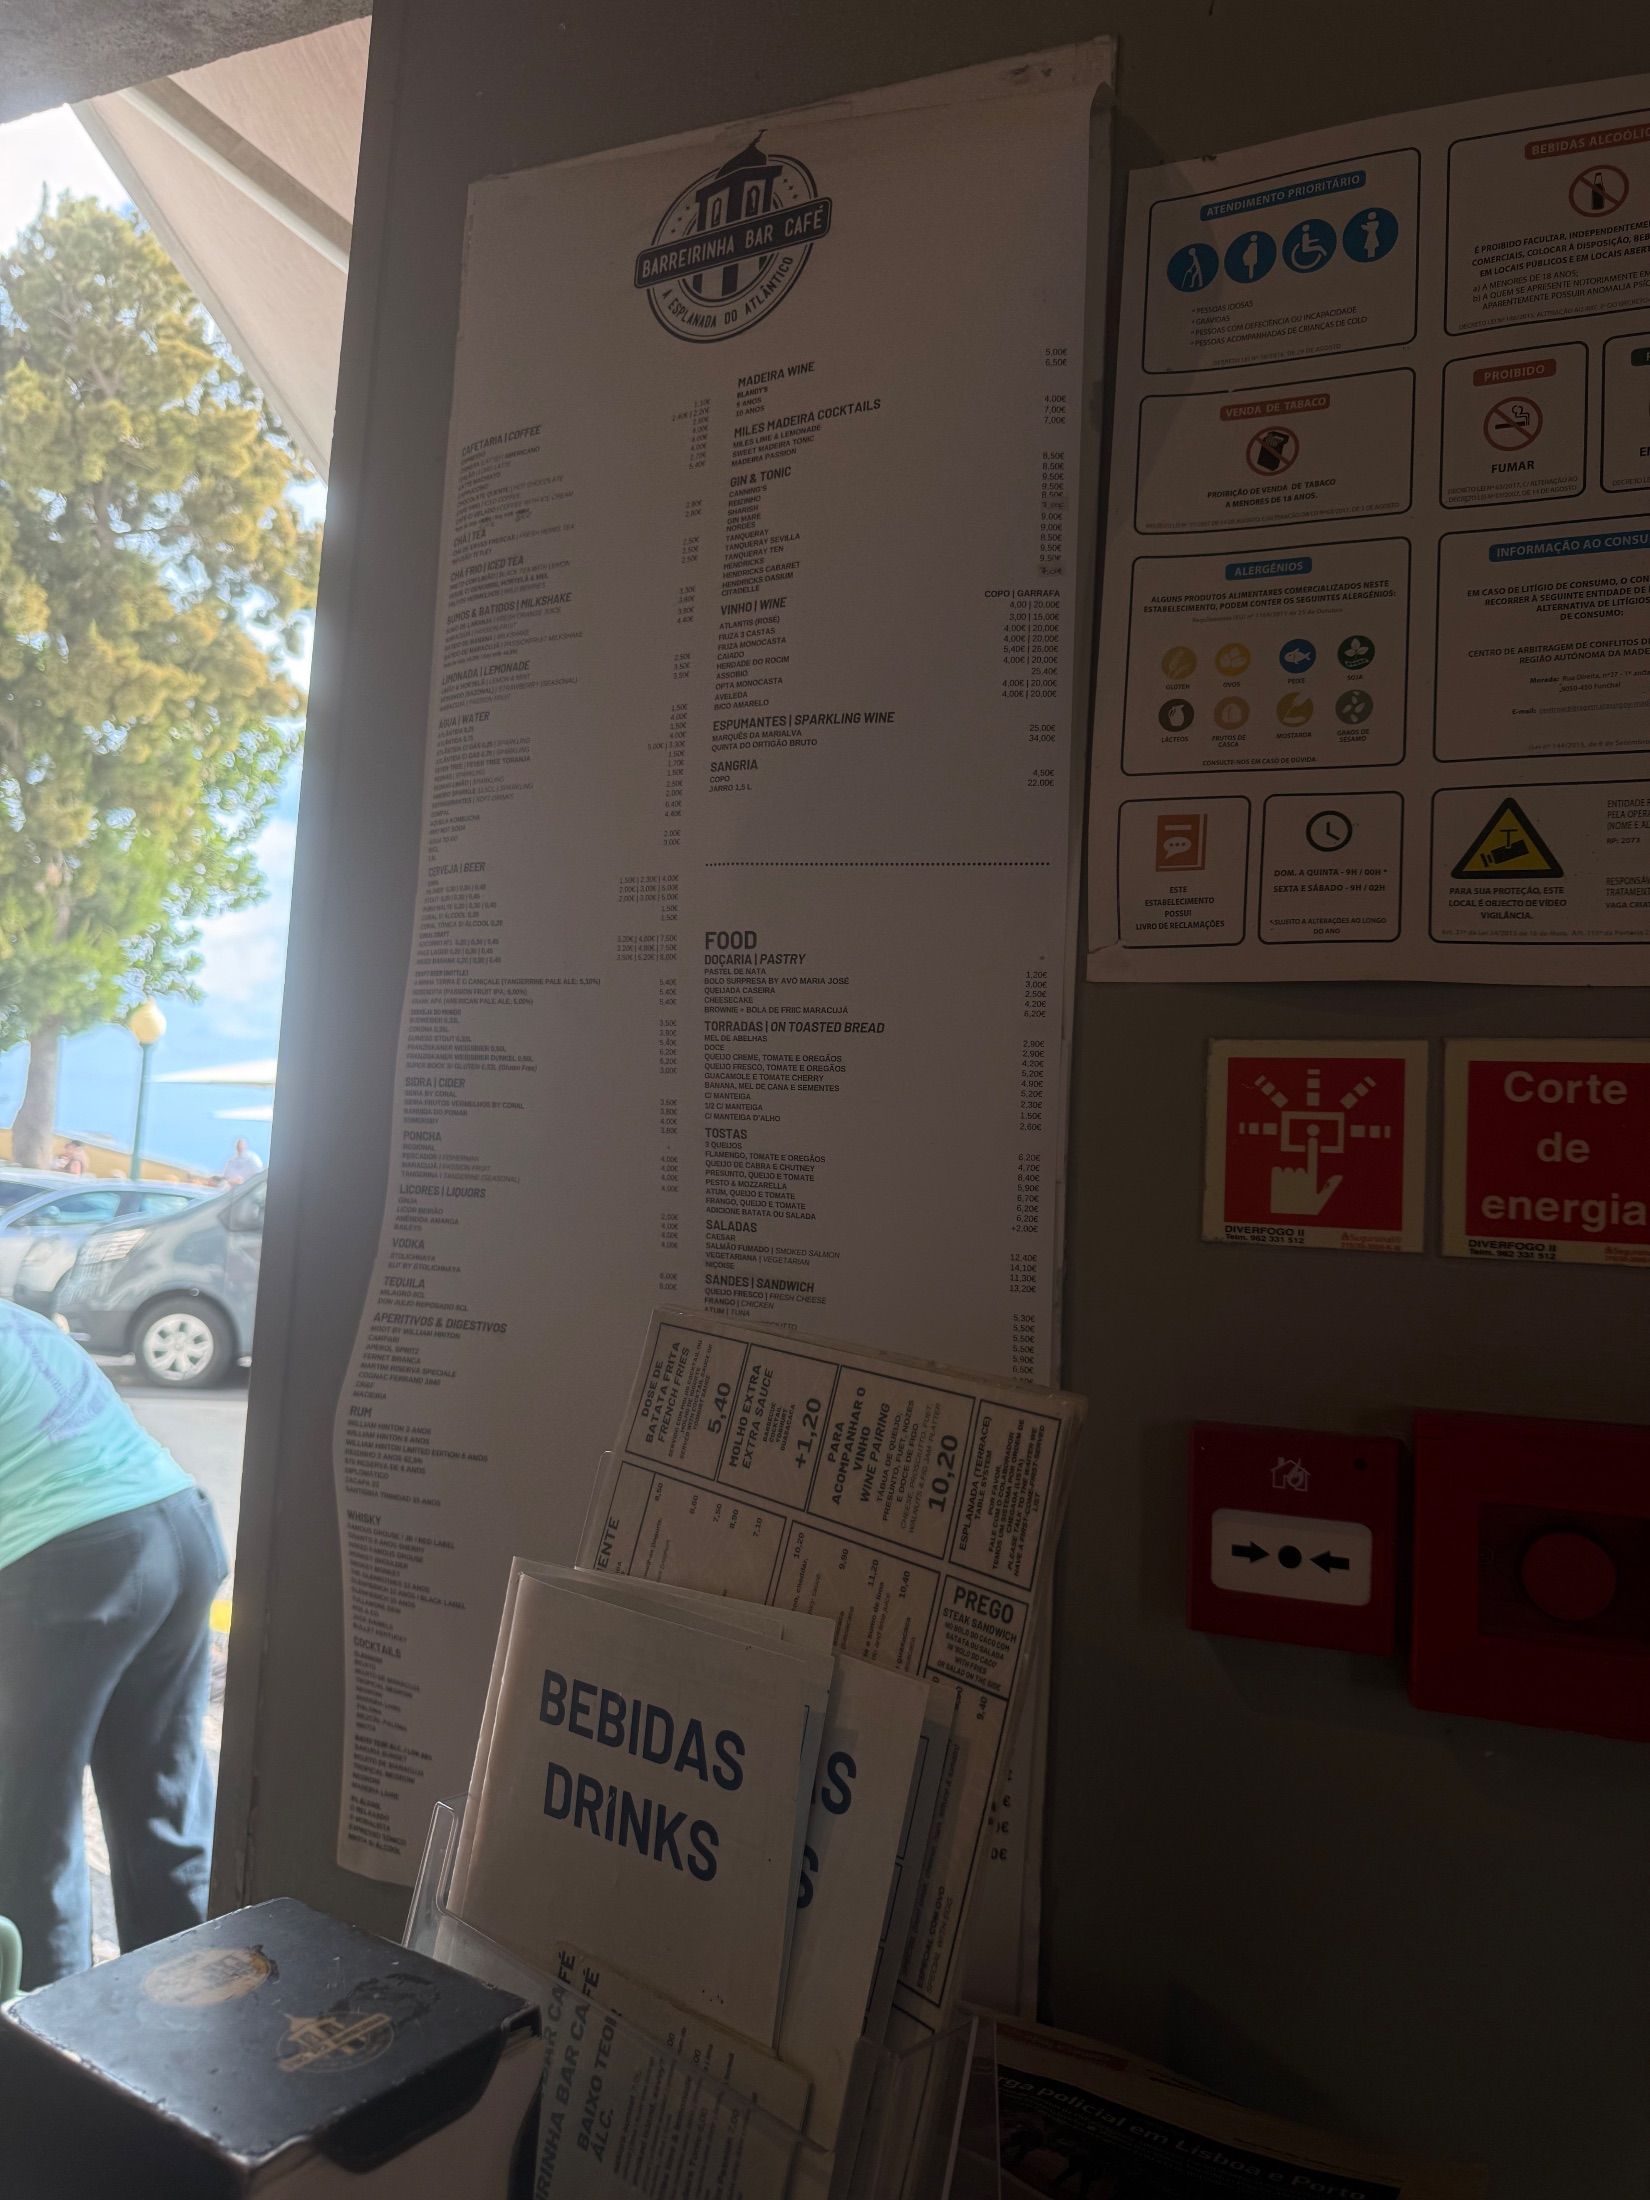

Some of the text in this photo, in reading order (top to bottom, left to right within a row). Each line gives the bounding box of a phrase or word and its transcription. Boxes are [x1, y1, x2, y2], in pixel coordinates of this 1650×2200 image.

[1531, 138, 1585, 154] BEBIDAS
[1206, 173, 1360, 215] ATENDIMENTO PRIORITÁRIO
[642, 205, 824, 278] BARREIRINHA BAR CAFÉ
[662, 256, 793, 328] A ESPLANADA DO ATLÂNTICO
[737, 361, 813, 387] MADEIRA WINE
[1484, 364, 1544, 381] PROIBIDO
[734, 397, 880, 438] MILES MADEIRA COCKTAILS
[1225, 396, 1325, 417] VENDA DE TABACO
[730, 466, 791, 487] GIN & TONIC
[1491, 460, 1534, 472] FUMAR
[1496, 537, 1580, 558] INFORMAÇÃO
[1582, 538, 1601, 548] AO
[1234, 559, 1303, 576] ALERGÉNIOS
[1151, 580, 1388, 603] ALGUNS PRODUTOS ALIMENTARES COMERCIALIZADOS NESTE
[720, 601, 752, 615] VINHO
[760, 597, 785, 609] WINE
[712, 715, 786, 730] ESPUMANTES
[794, 712, 861, 726] SPARKLING
[864, 711, 894, 723] WINE
[710, 759, 757, 772] SANGRIA
[1307, 882, 1343, 891] SÁBADO
[1492, 885, 1541, 895] PROTEÇÃO,
[1144, 897, 1214, 905] ESTABELECIMENTO
[1164, 909, 1191, 917] POSSUI
[1538, 897, 1566, 906] VÍDEO
[1169, 919, 1224, 929] RECLAMAÇÕES
[1480, 910, 1532, 919] VIGILÂNCIA.
[705, 930, 756, 949] FOOD
[704, 954, 752, 966] DOÇARIA
[759, 953, 805, 964] PASTRY
[705, 1020, 763, 1031] TORRADAS
[770, 1021, 786, 1031] ON
[789, 1021, 841, 1032] TOASTED
[843, 1022, 884, 1033] BREAD
[1504, 1070, 1629, 1104] Corte
[706, 1127, 747, 1139] TOSTAS
[1536, 1132, 1591, 1164] de
[399, 1184, 439, 1195] LICORES
[446, 1186, 485, 1199] LIQUORS
[705, 1219, 757, 1231] SALADAS
[1481, 1193, 1648, 1233] energia
[1224, 1225, 1294, 1235] DIVERFOGO
[704, 1273, 749, 1287] SANDES
[756, 1278, 814, 1292] SANDWICH
[373, 1311, 433, 1326] APERITIVOS
[445, 1318, 507, 1333] DIGESTIVOS
[641, 1361, 663, 1417] DOSE DE
[646, 1342, 680, 1443] BATATA FRITA
[658, 1347, 689, 1442] FRENCH FRIES
[349, 1405, 371, 1417] RUM
[708, 1382, 731, 1434] 5,40
[729, 1365, 762, 1468] MOLHO EXTRA
[742, 1368, 773, 1468] EXTRA SAUCE
[795, 1398, 821, 1468] +1,20
[828, 1422, 844, 1462] PARA
[832, 1387, 866, 1505] ACOMPANHAR O
[853, 1426, 871, 1470] VINHO
[860, 1403, 890, 1502] WINE PAIRING
[928, 1435, 958, 1512] 10,20
[959, 1416, 992, 1551] ESPLANADA (TERRACE)
[953, 1586, 1014, 1624] PREGO
[943, 1608, 1017, 1643] STEAK SANDWICH
[540, 1668, 745, 1791] BEBIDAS
[543, 1761, 719, 1882] DRINKS
[556, 2045, 580, 2104] BAR
[578, 2076, 602, 2151] BAIXO
[1038, 2087, 1366, 2200] policial em Lisboa e Porto
